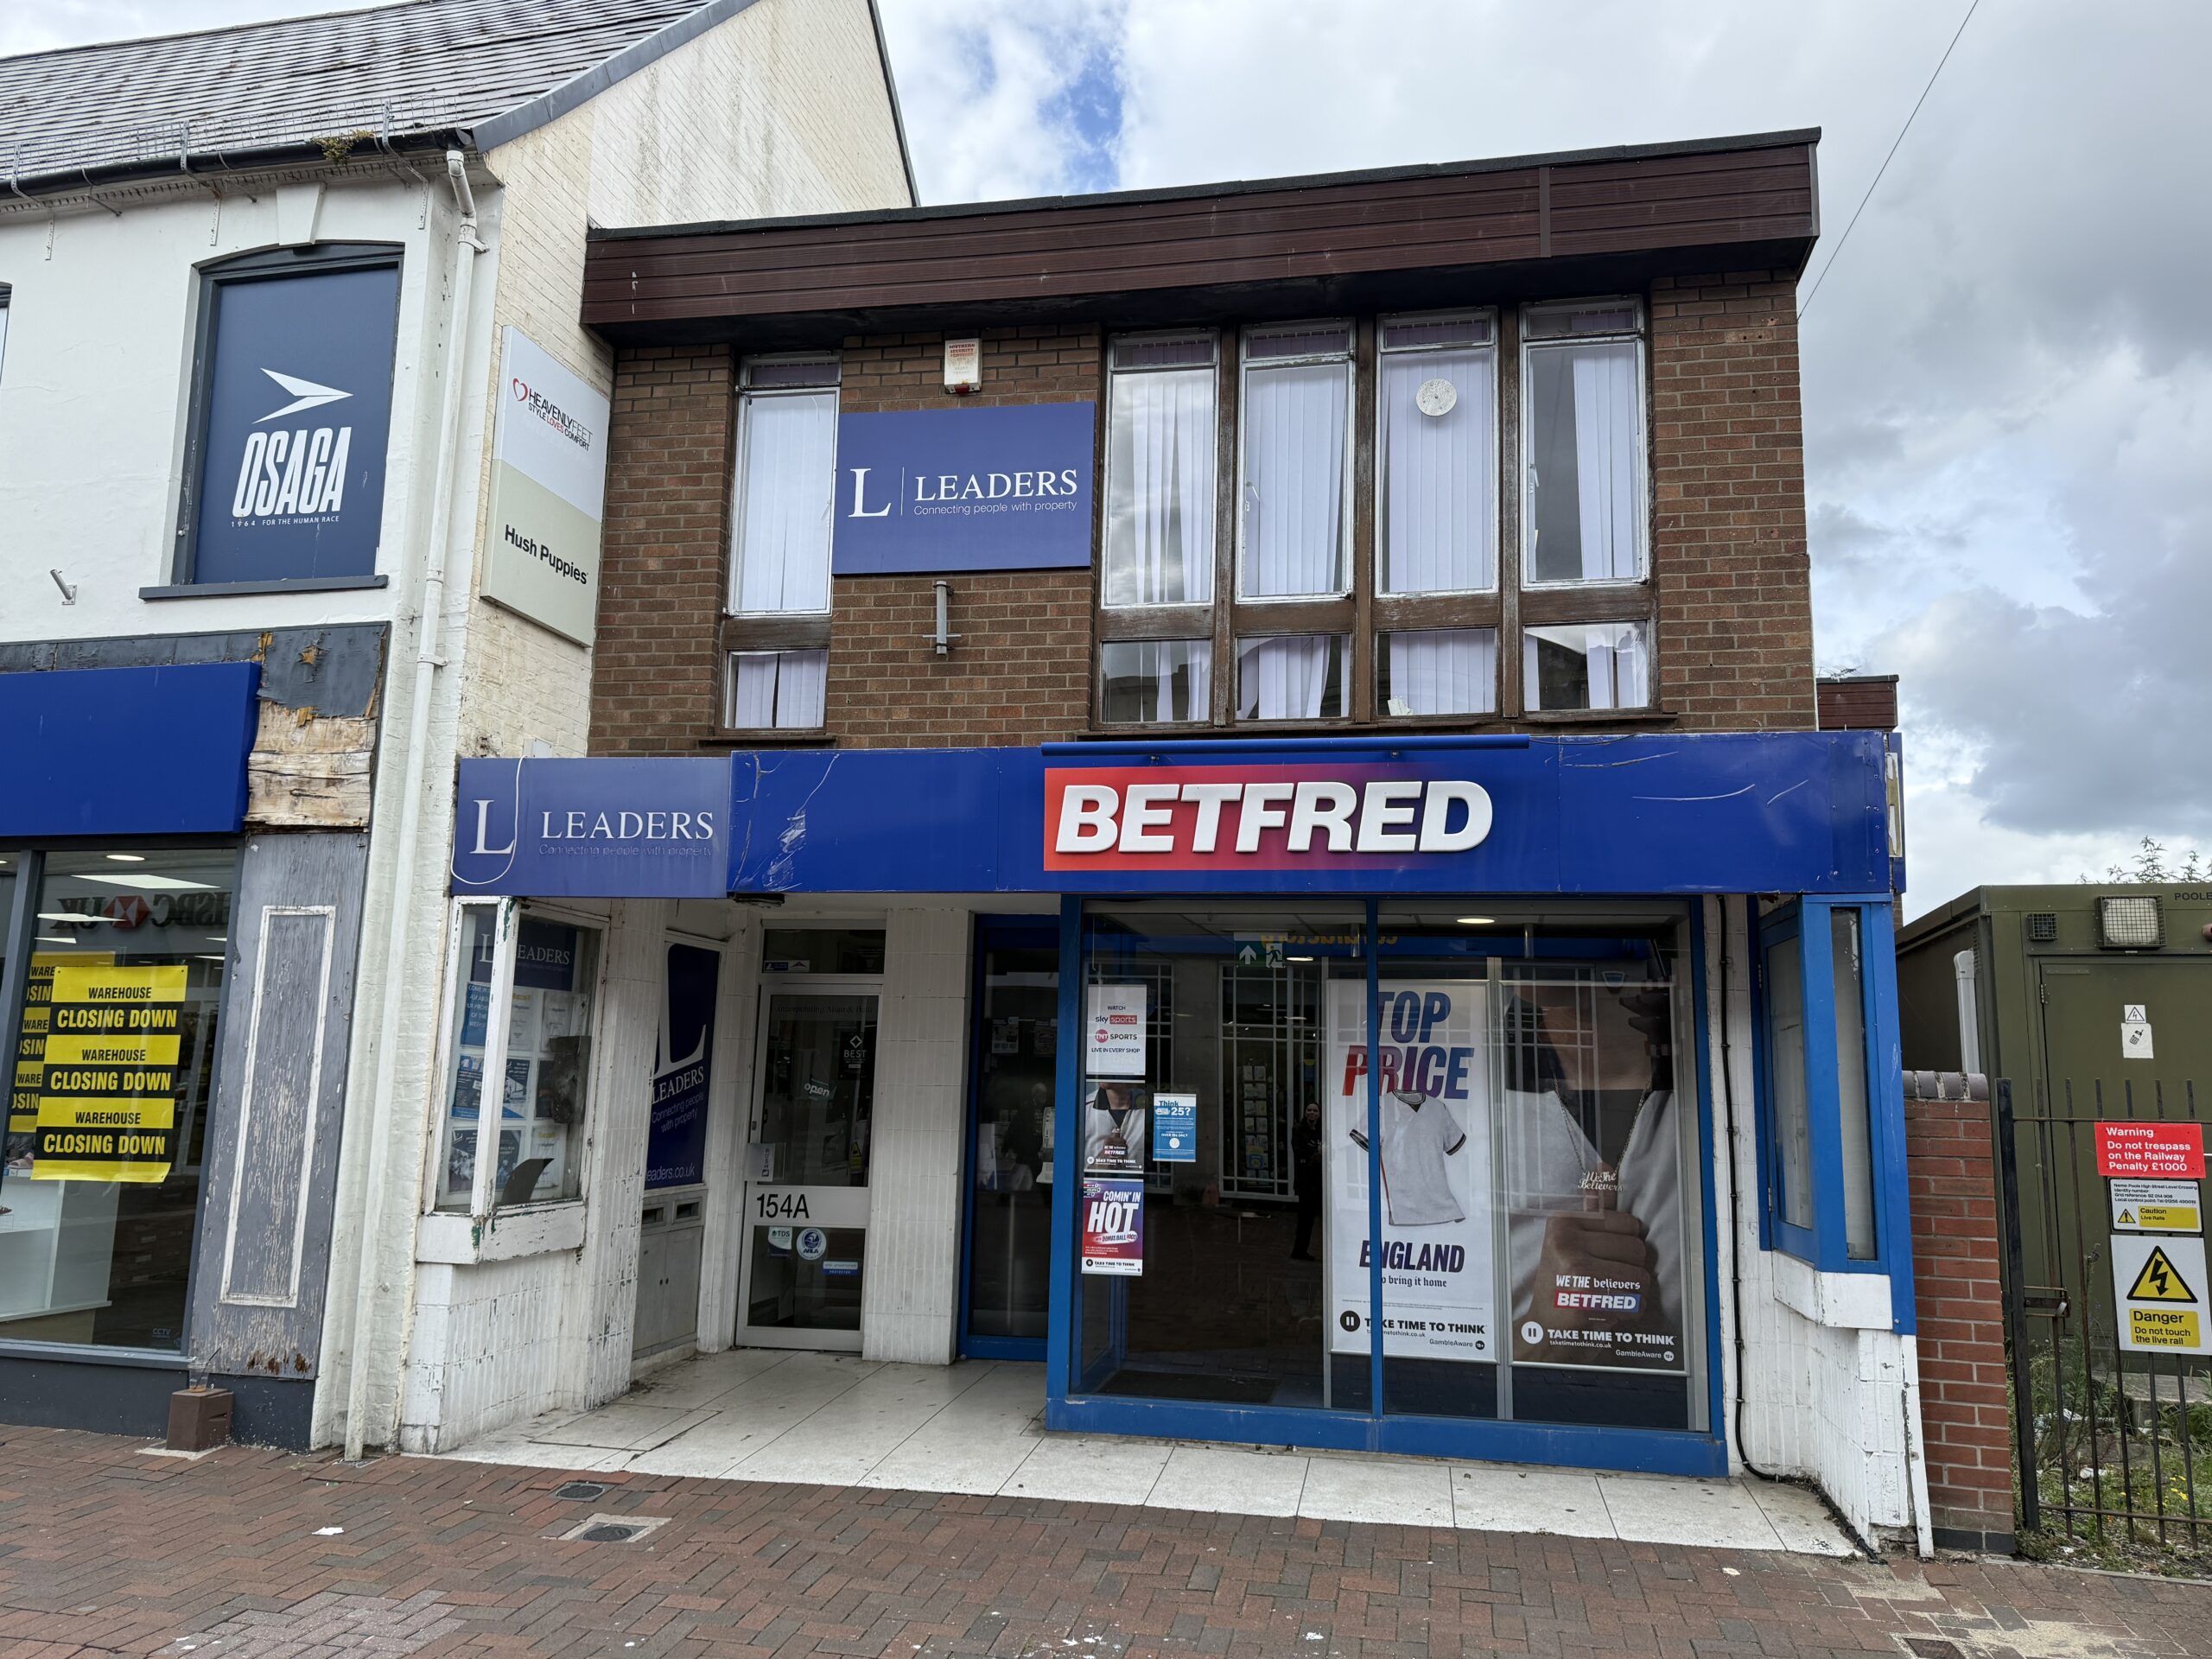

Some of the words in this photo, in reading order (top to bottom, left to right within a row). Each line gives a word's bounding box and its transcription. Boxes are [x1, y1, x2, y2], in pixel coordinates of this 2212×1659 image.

[528, 402, 546, 422] STYLE
[546, 415, 564, 434] LOVES
[564, 428, 590, 451] COMFORT
[232, 426, 352, 518] OSAGA
[848, 467, 892, 518] L
[914, 469, 1077, 501] LEADERS
[913, 504, 970, 516] Connecting
[974, 503, 1007, 514] people
[1011, 501, 1032, 512] with
[1034, 500, 1077, 512] property
[505, 524, 537, 557] Hush
[540, 544, 588, 585] Puppies
[1054, 779, 1494, 854] BETFRED
[469, 799, 515, 855] L
[540, 810, 714, 840] LEADERS
[539, 843, 600, 857] Connecting
[602, 844, 639, 858] people
[643, 843, 665, 855] with
[667, 844, 713, 858] property
[2174, 893, 2212, 901] POOLE
[517, 944, 570, 965] EADERS
[88, 987, 152, 1000] WAREHOUSE
[57, 1008, 124, 1028] CLOSING
[130, 1008, 177, 1028] DOWN
[1095, 1014, 1109, 1024] sky
[1378, 990, 1452, 1044] TOP
[82, 1049, 146, 1062] WAREHOUSE
[843, 1049, 868, 1058] BEST
[1342, 1045, 1475, 1100] PRICE
[50, 1071, 118, 1090] CLOSING
[123, 1071, 171, 1091] DOWN
[652, 1065, 704, 1105] LEADERS
[804, 1082, 830, 1096] open
[652, 1100, 685, 1123] Connecting
[685, 1091, 704, 1110] people
[1171, 1107, 1192, 1116] 25?
[75, 1111, 141, 1124] WAREHOUSE
[660, 1119, 674, 1134] with
[674, 1107, 698, 1130] property
[2106, 1127, 2154, 1138] Warning
[43, 1134, 112, 1154] CLOSING
[118, 1135, 166, 1155] DOWN
[2107, 1141, 2122, 1149] Do
[2145, 1141, 2191, 1151] trespass
[2144, 1152, 2185, 1162] Railway
[647, 1162, 695, 1183] eaders.co.uk
[2108, 1161, 2149, 1173] Penalty
[2152, 1162, 2188, 1172] £1000
[1103, 1191, 1132, 1203] COMIN'
[1132, 1192, 1141, 1203] IN
[756, 1192, 810, 1219] 154A
[1087, 1201, 1140, 1234] HOT
[1389, 1275, 1413, 1287] bring
[1414, 1275, 1421, 1287] it
[1423, 1277, 1447, 1288] home
[1555, 1274, 1571, 1288] WE
[1573, 1274, 1591, 1288] THE
[1593, 1277, 1641, 1290] believers
[1557, 1292, 1637, 1310] BETFRED
[2133, 1310, 2184, 1325] Danger
[1364, 1317, 1395, 1329] TKE
[1397, 1319, 1427, 1331] TIME
[1429, 1322, 1446, 1332] TO
[1448, 1323, 1485, 1335] THINK
[2165, 1328, 2191, 1337] touch
[1429, 1338, 1473, 1348] GambleAware
[1548, 1328, 1580, 1340] TAKE
[1582, 1330, 1612, 1342] TIME
[1615, 1332, 1633, 1343] TO
[1635, 1332, 1675, 1346] THINK
[1549, 1340, 1612, 1349] taketimetothink.co.uk
[2135, 1335, 2151, 1344] the
[2152, 1336, 2168, 1344] live
[2170, 1337, 2183, 1345] rail
[1615, 1349, 1662, 1359] GambleAware
